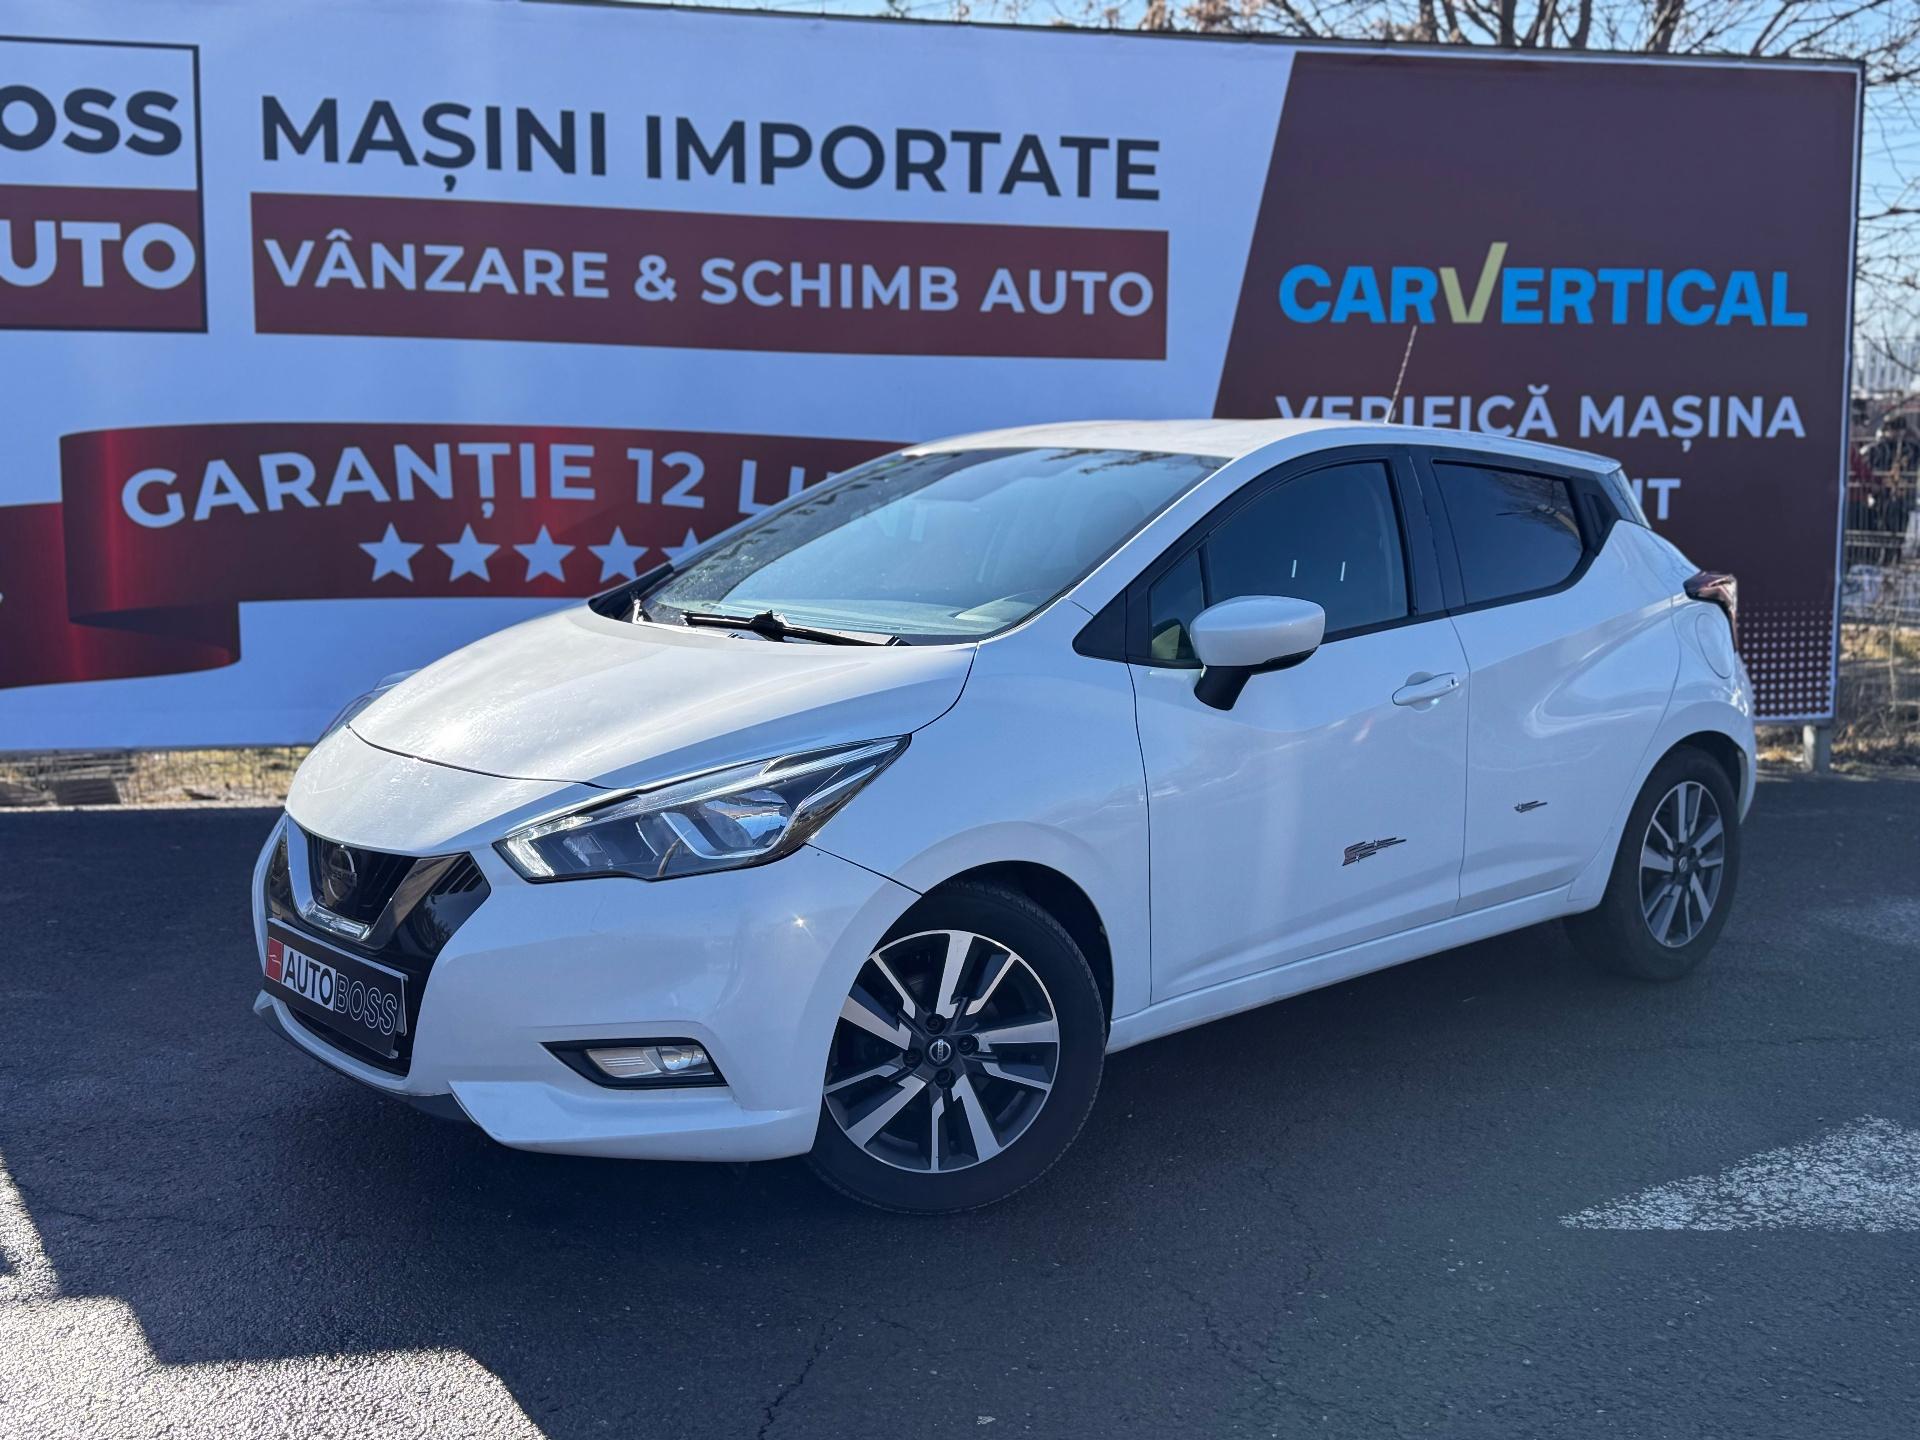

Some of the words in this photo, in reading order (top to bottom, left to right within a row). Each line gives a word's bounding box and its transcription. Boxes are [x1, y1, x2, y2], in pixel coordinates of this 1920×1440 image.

[263, 96, 606, 192] MAȘINI
[647, 116, 1159, 200] IMPORTATE
[264, 229, 608, 298] VÂNZARE
[635, 255, 676, 301] &
[702, 258, 958, 311] SCHIMB
[980, 269, 1153, 316] AUTO
[1279, 242, 1808, 326] CARVERTICAL
[1580, 396, 1806, 452] MAȘINA
[121, 442, 596, 528] GARANȚIE
[627, 448, 705, 509] 12
